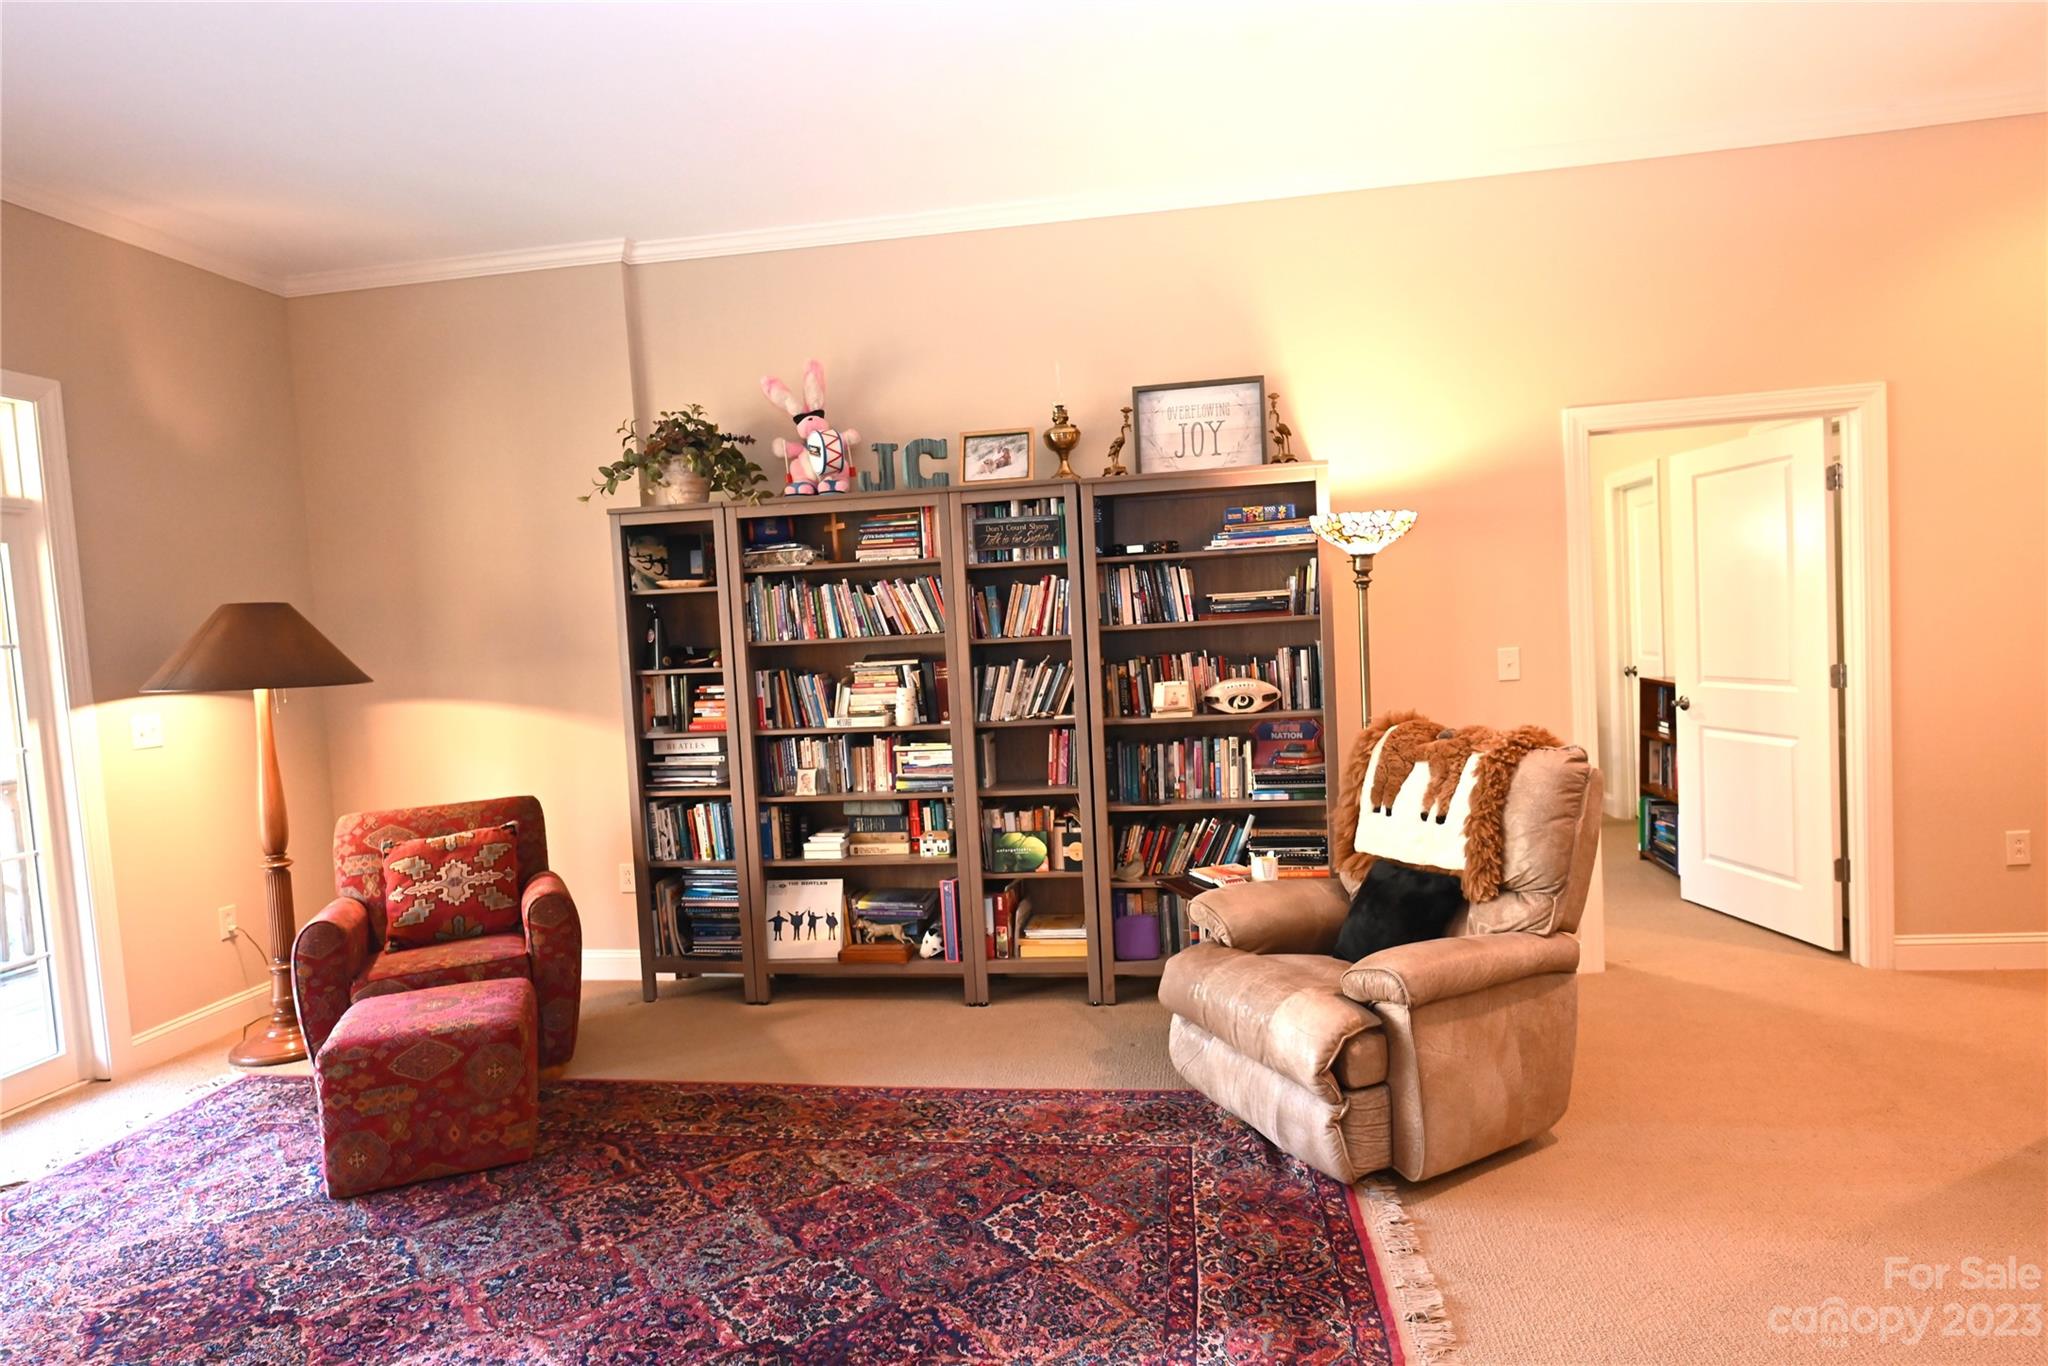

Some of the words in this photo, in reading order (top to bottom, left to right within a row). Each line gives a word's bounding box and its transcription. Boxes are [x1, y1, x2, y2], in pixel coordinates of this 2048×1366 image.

[1166, 402, 1231, 420] OVERFLOWING
[1174, 420, 1225, 458] JOY
[1005, 523, 1027, 532] Count
[1270, 731, 1304, 740] NATION
[666, 742, 706, 751] BEATLES
